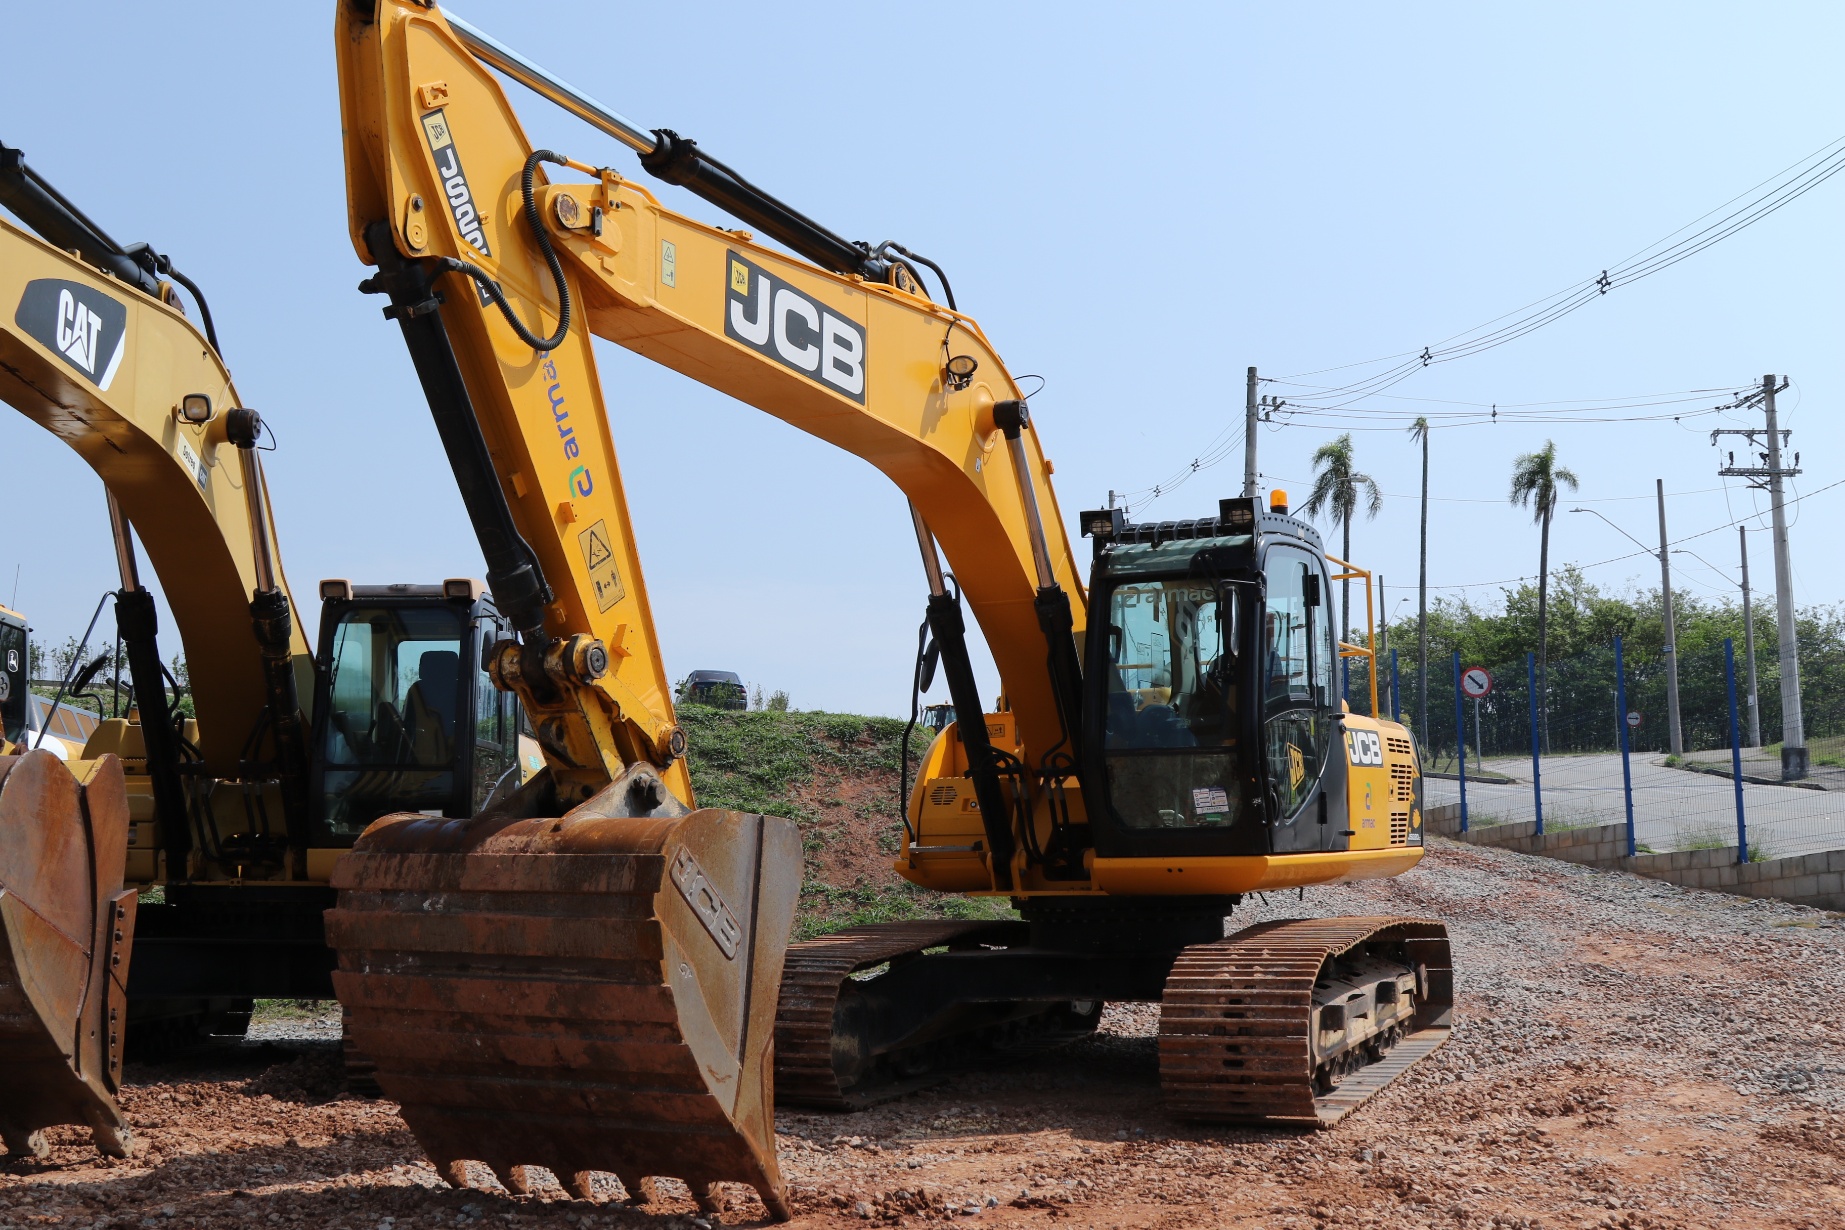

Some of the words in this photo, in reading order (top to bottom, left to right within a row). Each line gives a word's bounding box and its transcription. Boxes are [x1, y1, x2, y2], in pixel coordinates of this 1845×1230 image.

[430, 124, 445, 140] JCB
[56, 288, 102, 375] CAT
[730, 274, 864, 395] JCB
[1290, 747, 1305, 785] JCB
[1349, 731, 1383, 765] JCB
[669, 846, 743, 961] JCB
